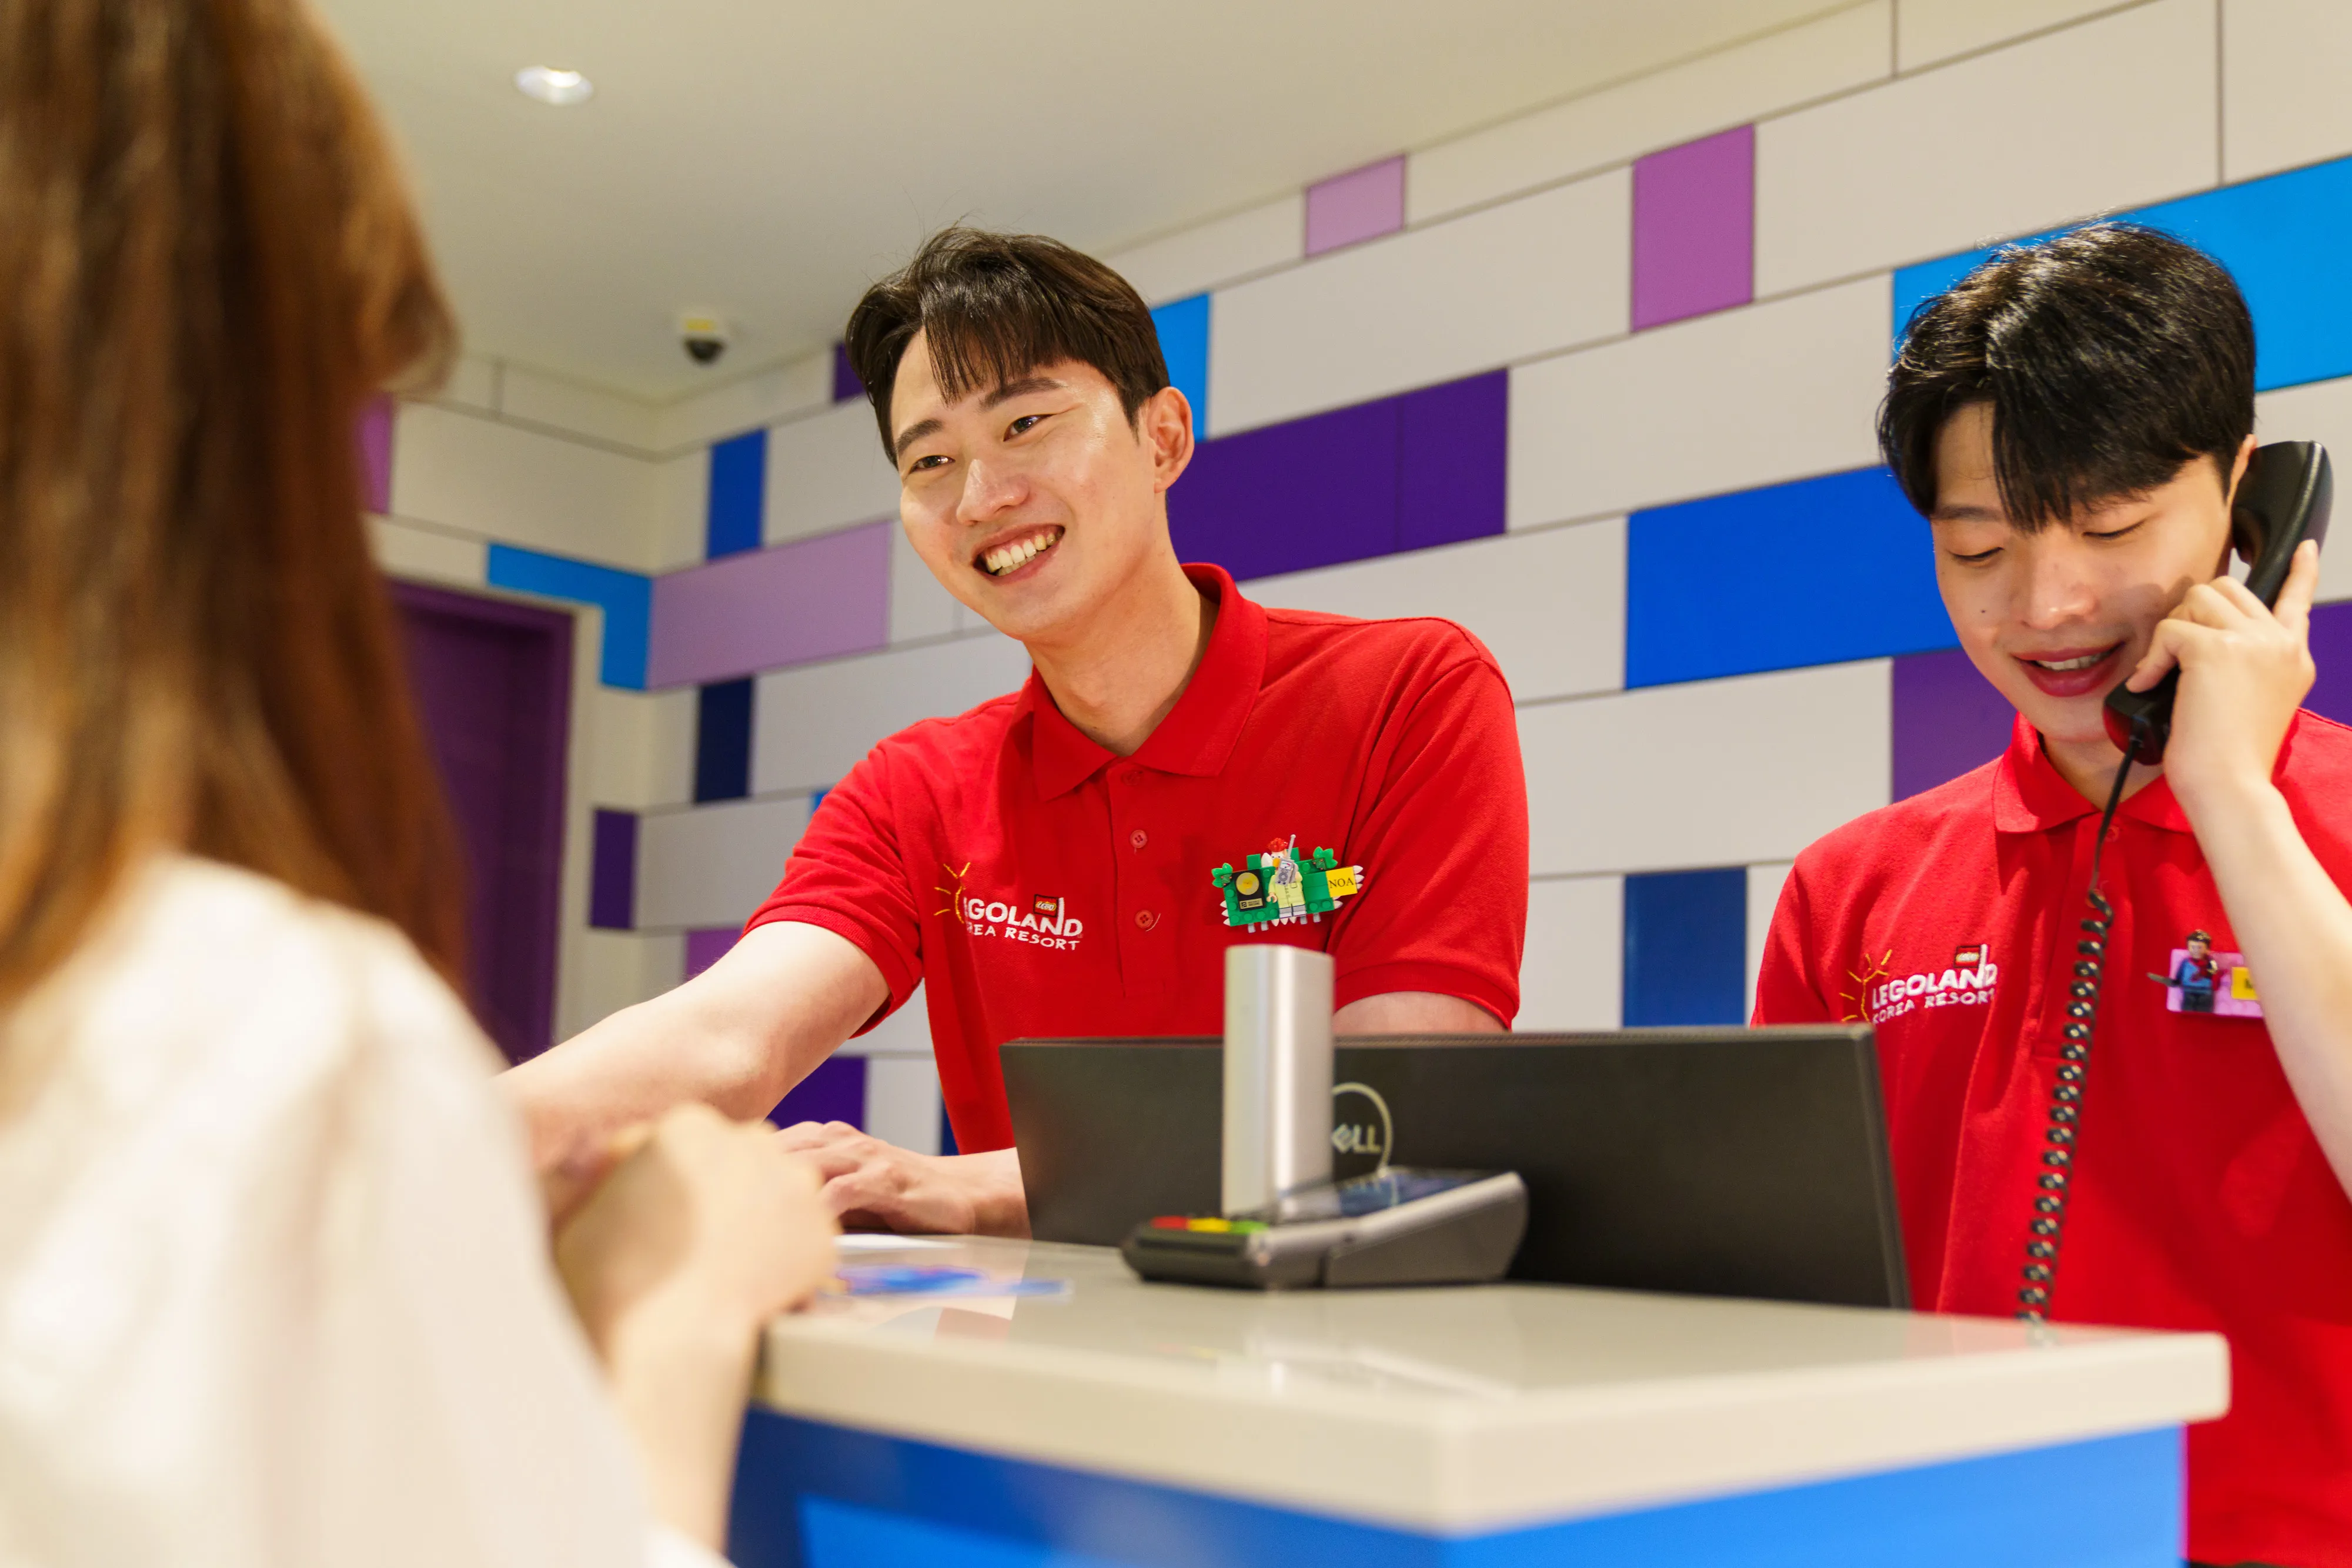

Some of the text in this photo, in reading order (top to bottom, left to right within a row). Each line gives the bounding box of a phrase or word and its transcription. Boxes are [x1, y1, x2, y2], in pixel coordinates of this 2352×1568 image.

[1328, 878, 1354, 888] NOA
[963, 897, 1083, 937] GOLAND
[1004, 927, 1080, 950] RESORT
[1872, 944, 1997, 1009] LEGOLAND
[1331, 1122, 1382, 1154] ELL
